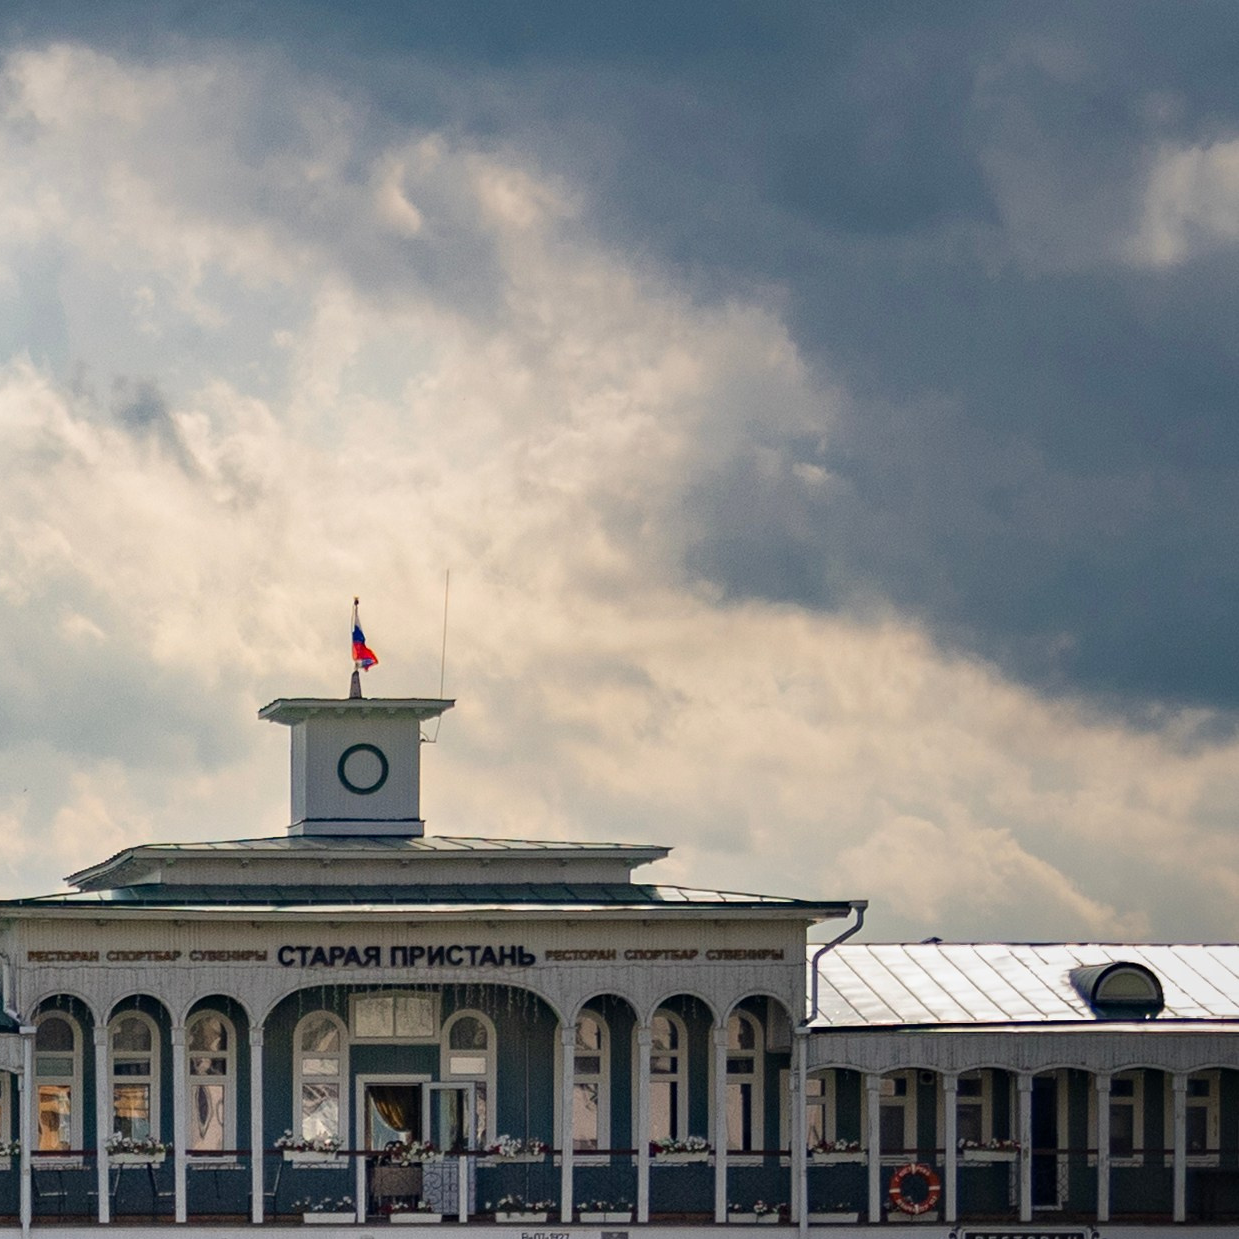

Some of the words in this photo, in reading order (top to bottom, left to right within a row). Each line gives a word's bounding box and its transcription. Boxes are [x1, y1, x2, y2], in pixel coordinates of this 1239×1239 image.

[27, 950, 100, 962] РЕСТОРАН
[106, 950, 182, 962] СПОРТБАР
[189, 950, 268, 962] СУВЕНИРЫ
[277, 945, 381, 967] СТАРАЯ
[390, 945, 537, 967] ПРИСТАНЬ
[545, 949, 617, 962] РЕСТОРАН
[624, 949, 699, 962] СПОРТБАР
[705, 949, 785, 962] СУВЕНИРЫ
